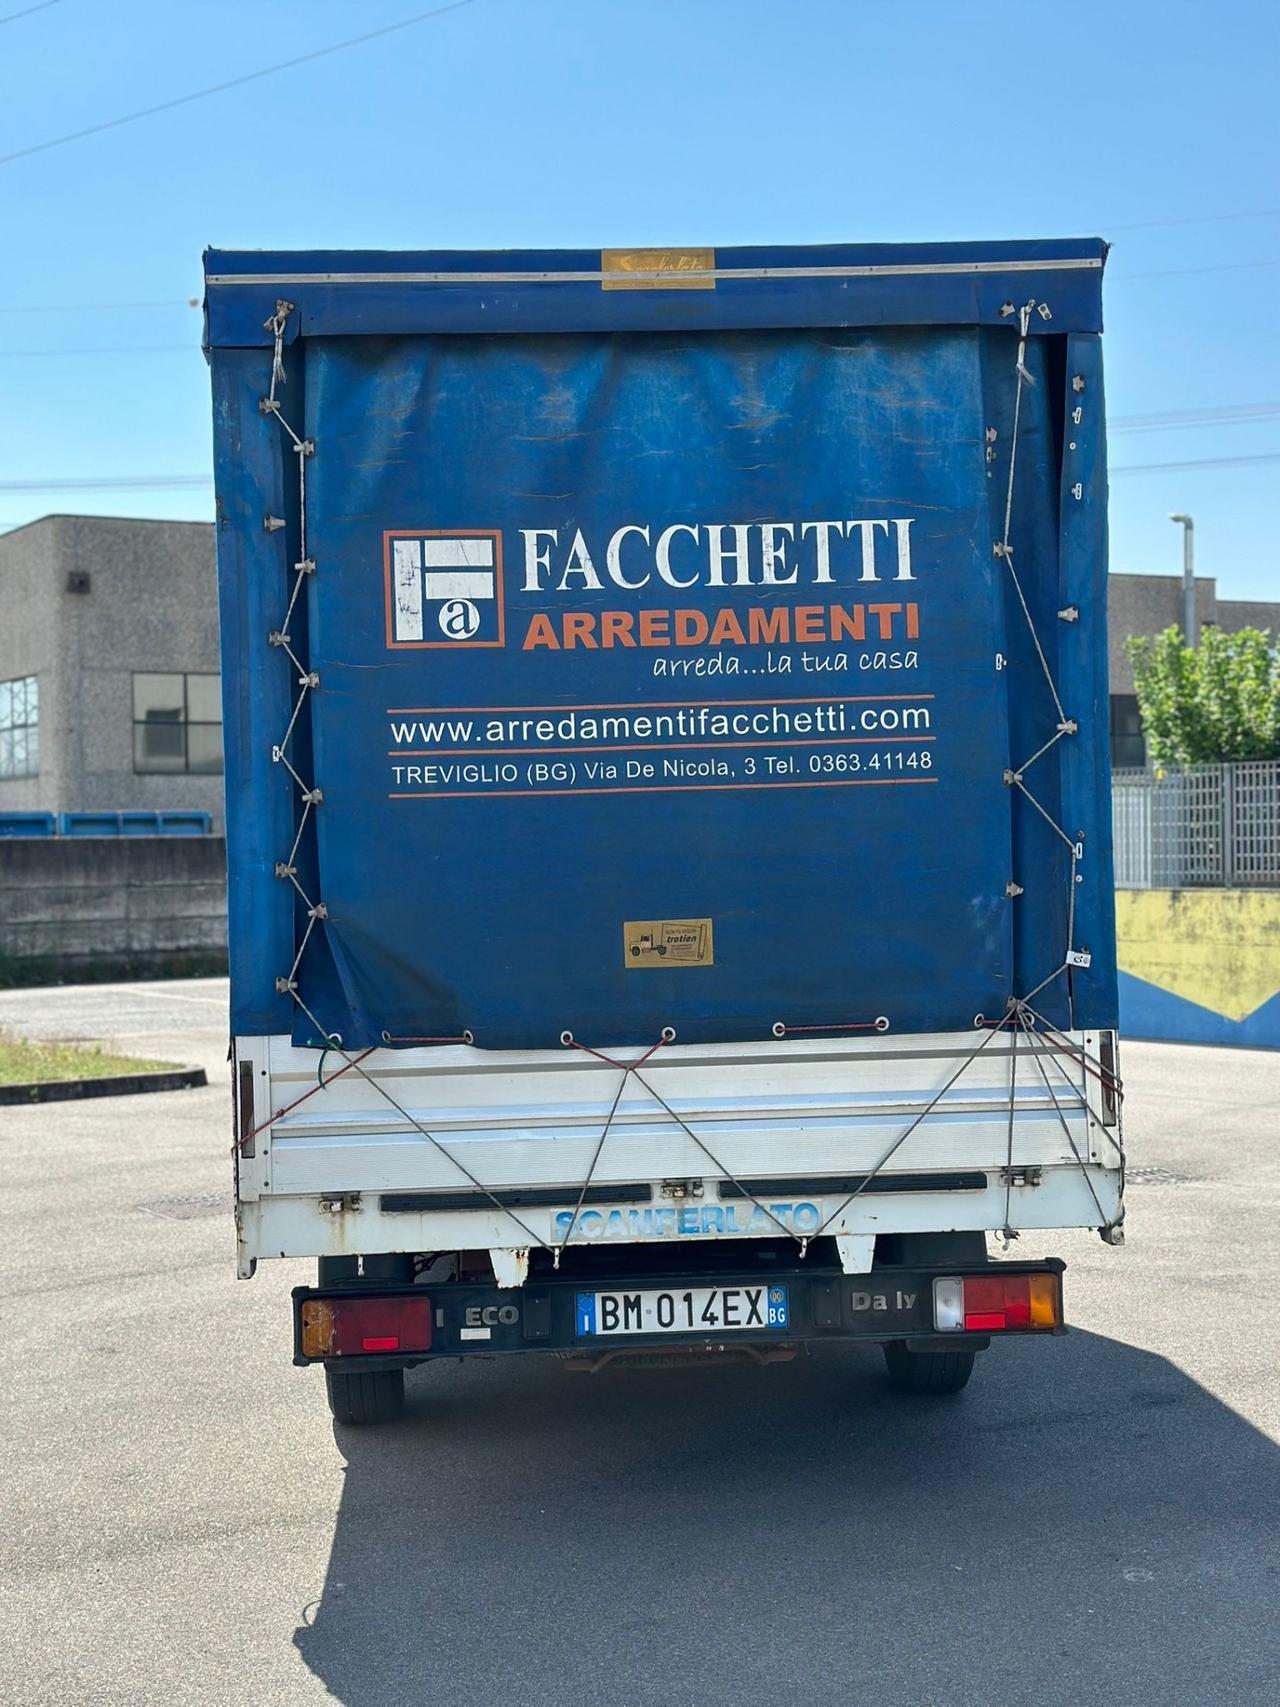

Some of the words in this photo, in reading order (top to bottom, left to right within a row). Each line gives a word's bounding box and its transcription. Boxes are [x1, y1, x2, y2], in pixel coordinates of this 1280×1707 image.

[518, 518, 917, 592] FACCHETTI
[521, 602, 920, 651] ARREDAMENTI
[803, 650, 848, 672] tua
[858, 650, 919, 671] casa
[390, 704, 931, 743] www.arredamentifacchetti.com
[391, 763, 518, 785] TREVIGLIO
[526, 762, 577, 784] (BG)
[584, 761, 617, 780] Via
[625, 760, 656, 778] De
[663, 757, 737, 779] Nicola,
[744, 757, 757, 775] 3
[765, 756, 801, 774] Tel.
[808, 752, 933, 773] 0363.41148
[554, 1202, 820, 1239] SCANFERLATO
[601, 1294, 643, 1331] BM
[656, 1289, 763, 1328] 014EX
[769, 1307, 786, 1324] BG
